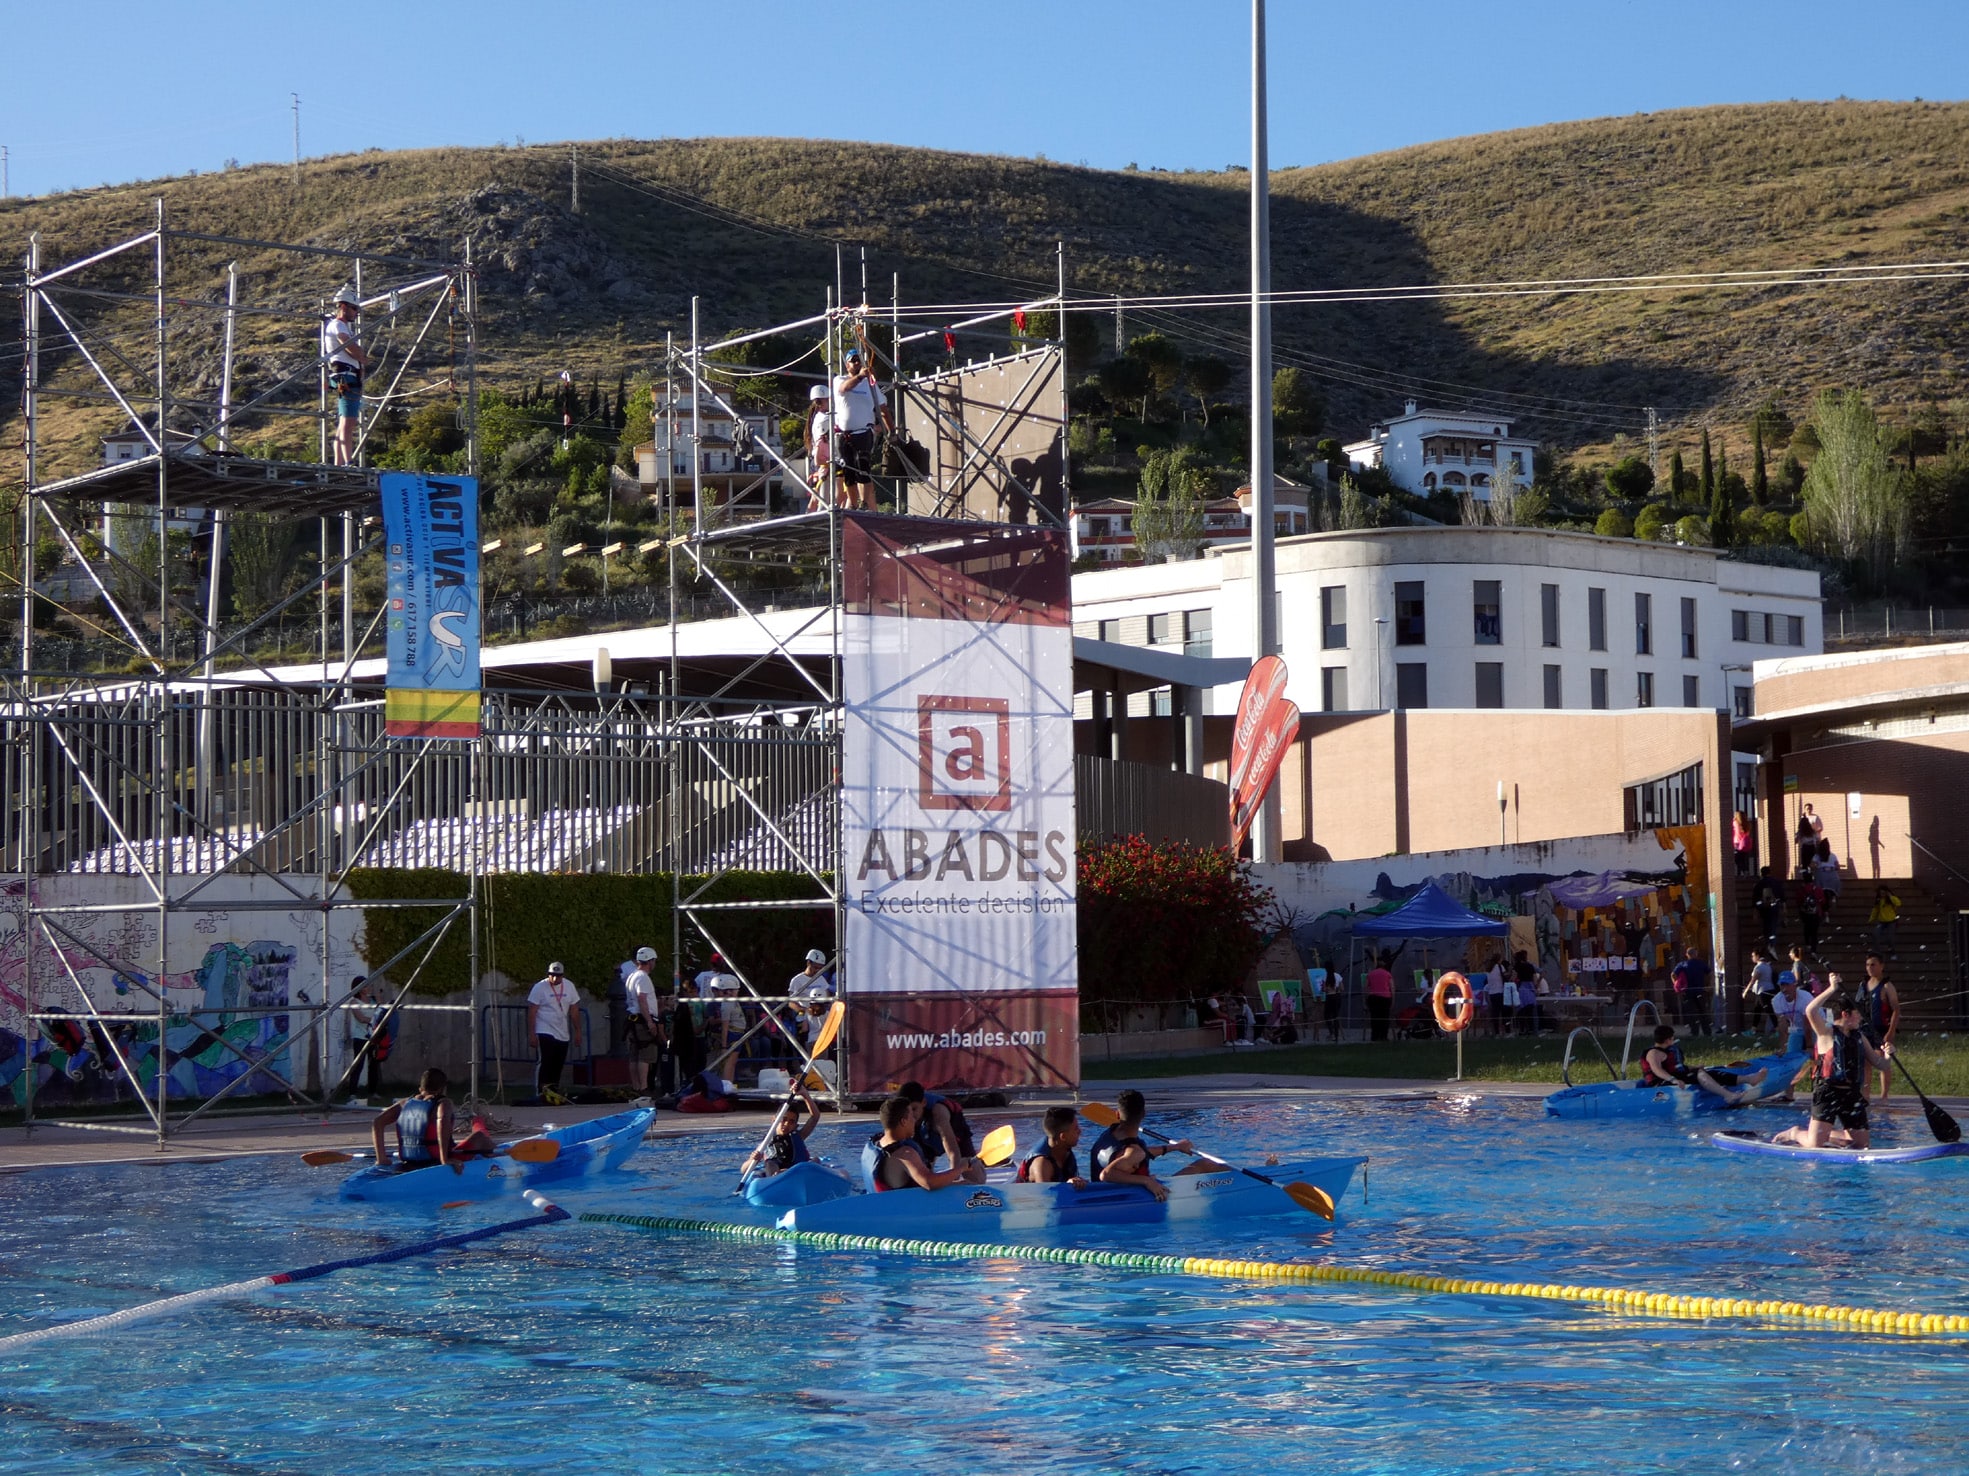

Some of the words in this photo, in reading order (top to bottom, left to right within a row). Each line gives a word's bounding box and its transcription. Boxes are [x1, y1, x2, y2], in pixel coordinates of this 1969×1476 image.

[401, 488, 415, 591] www.activasur.com
[407, 602, 417, 622] 617
[407, 625, 417, 645] 158
[406, 648, 416, 667] 788
[945, 726, 985, 781] a
[857, 828, 1068, 883] ABADES
[861, 889, 970, 914] Excelente
[978, 889, 1065, 914] decisión
[886, 1028, 1047, 1049] www.abades.com
